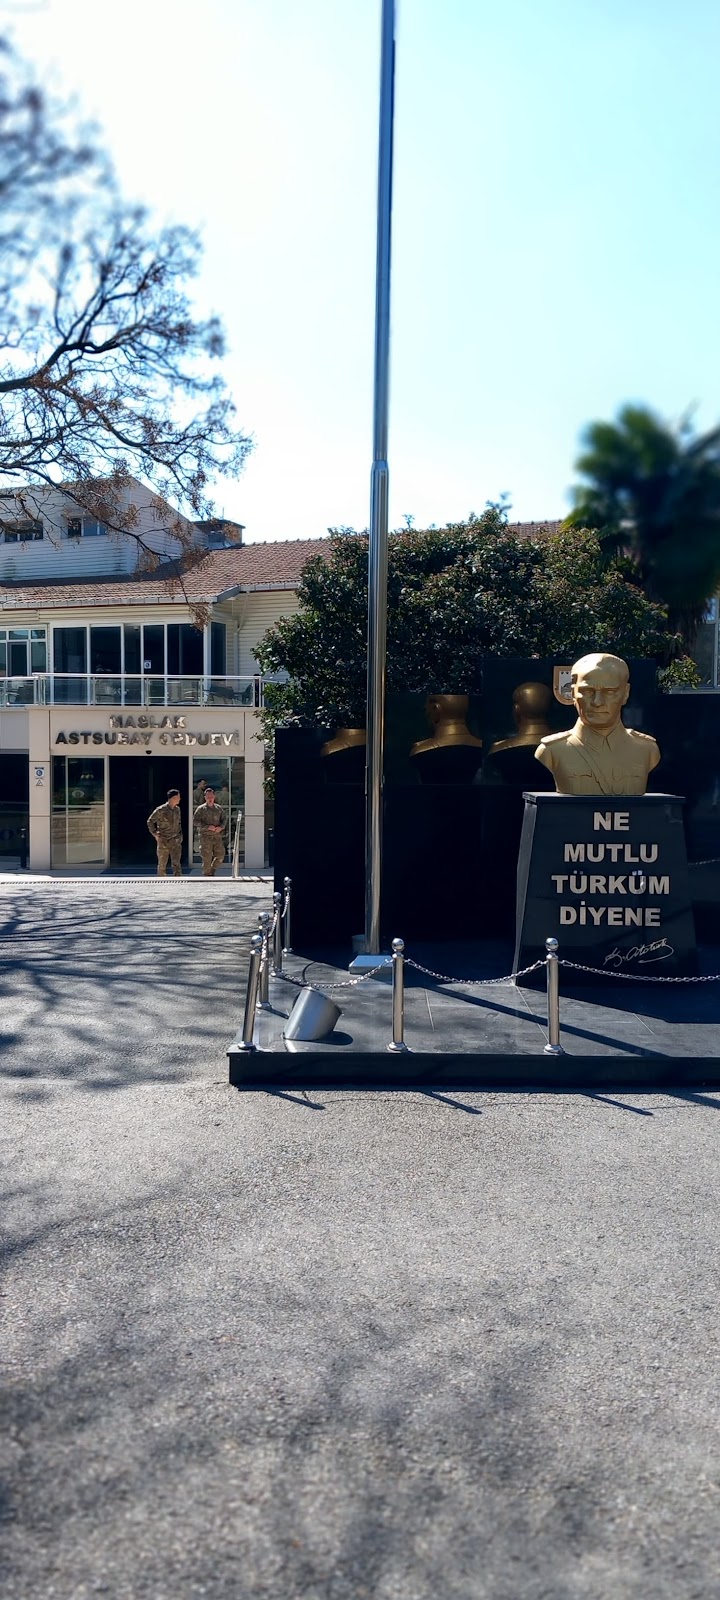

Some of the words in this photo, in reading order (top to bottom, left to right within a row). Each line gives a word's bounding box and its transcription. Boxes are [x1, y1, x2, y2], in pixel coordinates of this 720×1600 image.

[109, 715, 187, 729] MASLAK
[55, 731, 152, 746] ASTSUBAY
[160, 729, 240, 746] ORDUEVİ
[593, 811, 630, 831] NE
[564, 843, 659, 863] MUTLU
[551, 870, 670, 895] TÜRKÜM
[559, 900, 661, 927] DİYENE
